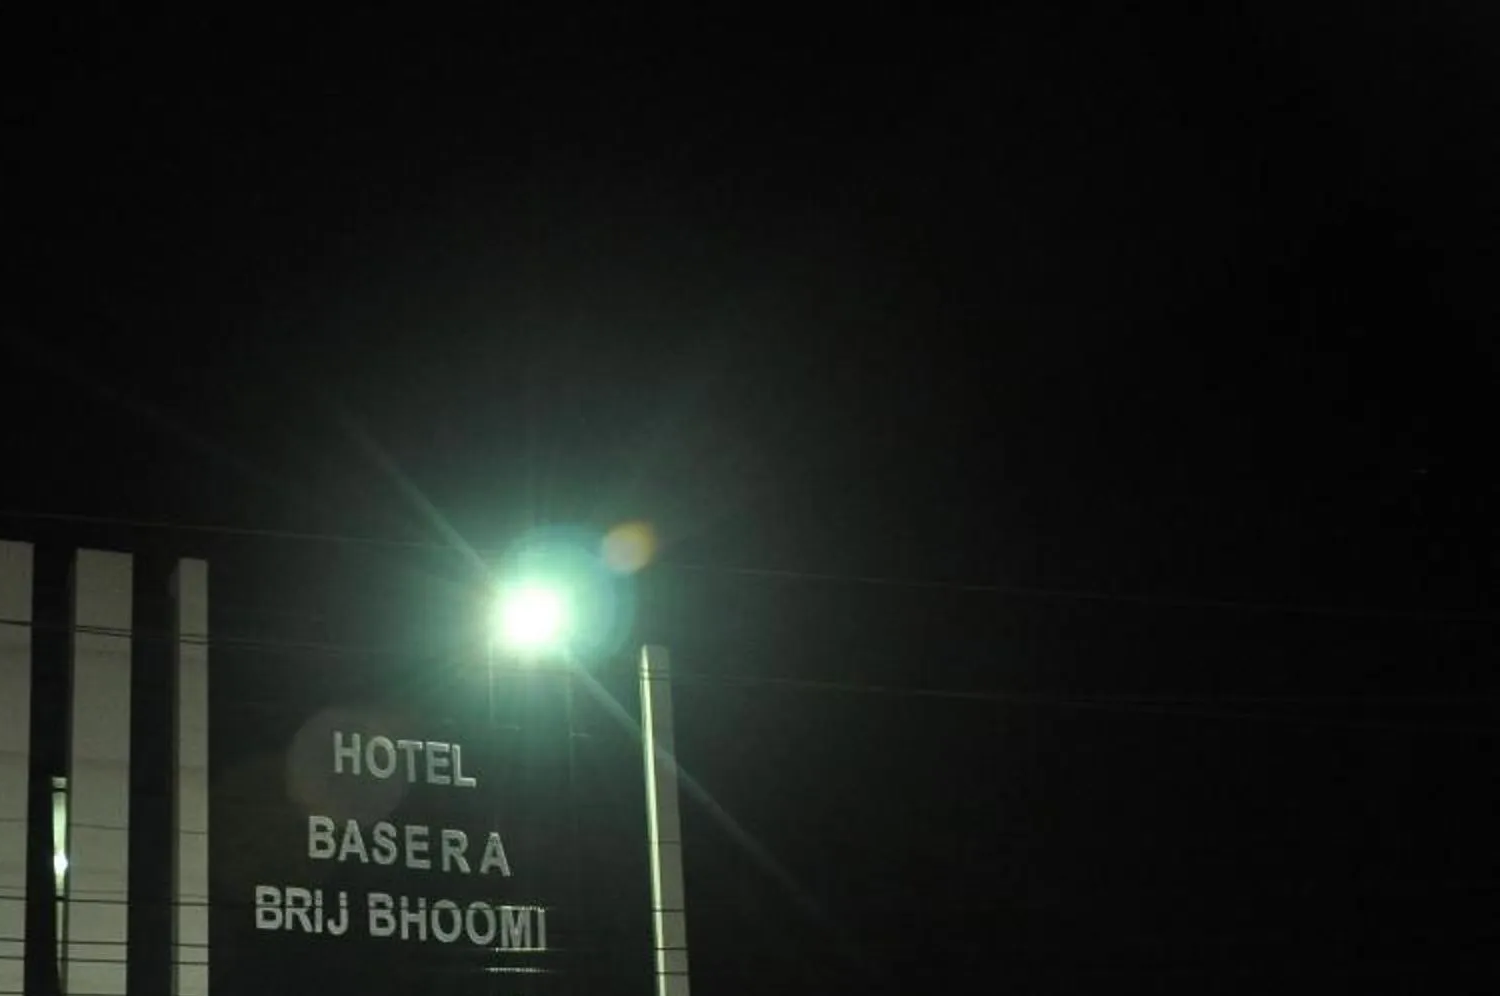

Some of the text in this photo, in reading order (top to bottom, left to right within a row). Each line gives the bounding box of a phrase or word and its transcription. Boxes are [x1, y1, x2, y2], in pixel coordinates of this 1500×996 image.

[334, 731, 477, 788] HOTEL
[308, 815, 512, 877] BASERA
[255, 885, 547, 951] BRIJ BHOOMI
